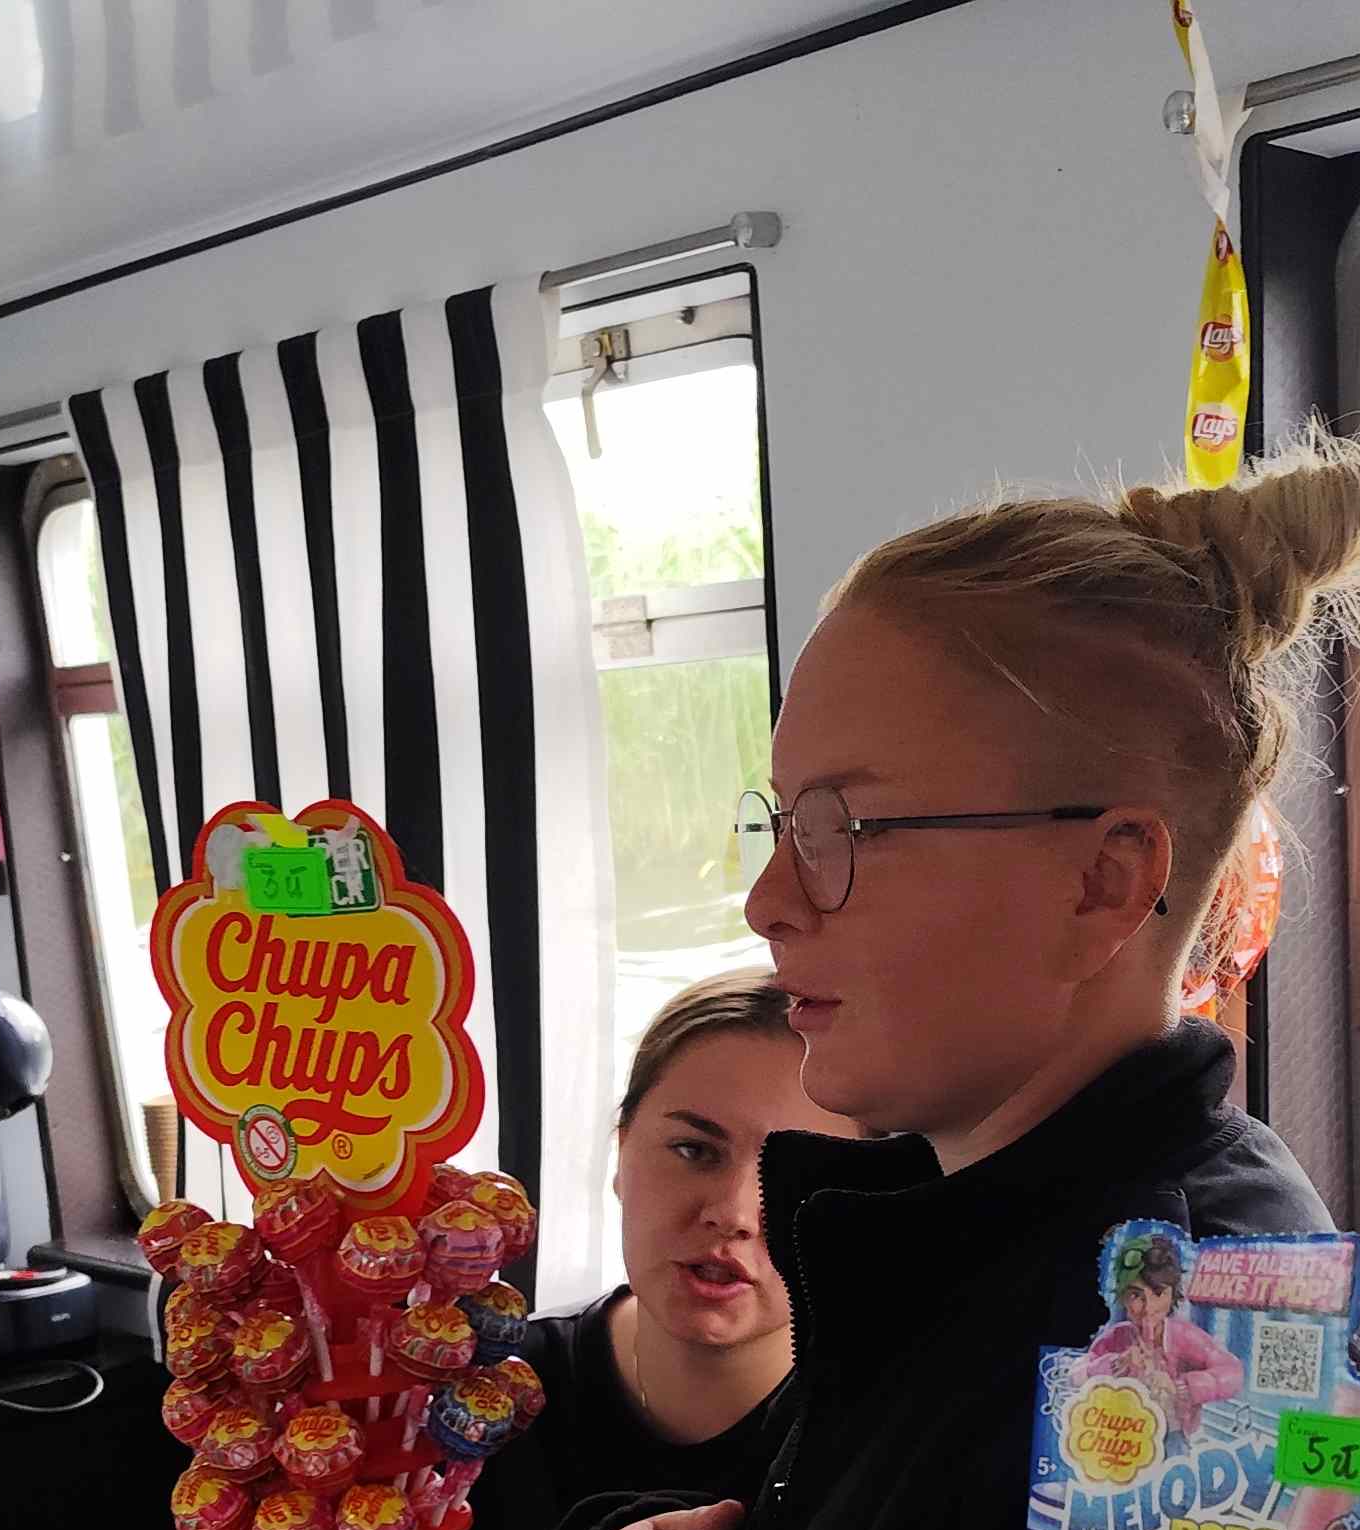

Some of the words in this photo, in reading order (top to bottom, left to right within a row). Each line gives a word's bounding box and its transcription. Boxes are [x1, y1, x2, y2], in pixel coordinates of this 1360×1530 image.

[206, 911, 416, 1024] Chupa
[206, 1002, 413, 1146] Chups
[1199, 1252, 1245, 1274] HAVE
[1191, 1274, 1249, 1298] MAKE
[1083, 1406, 1147, 1438] Chupa
[1078, 1430, 1142, 1467] Chups
[1037, 1457, 1057, 1476] 5+
